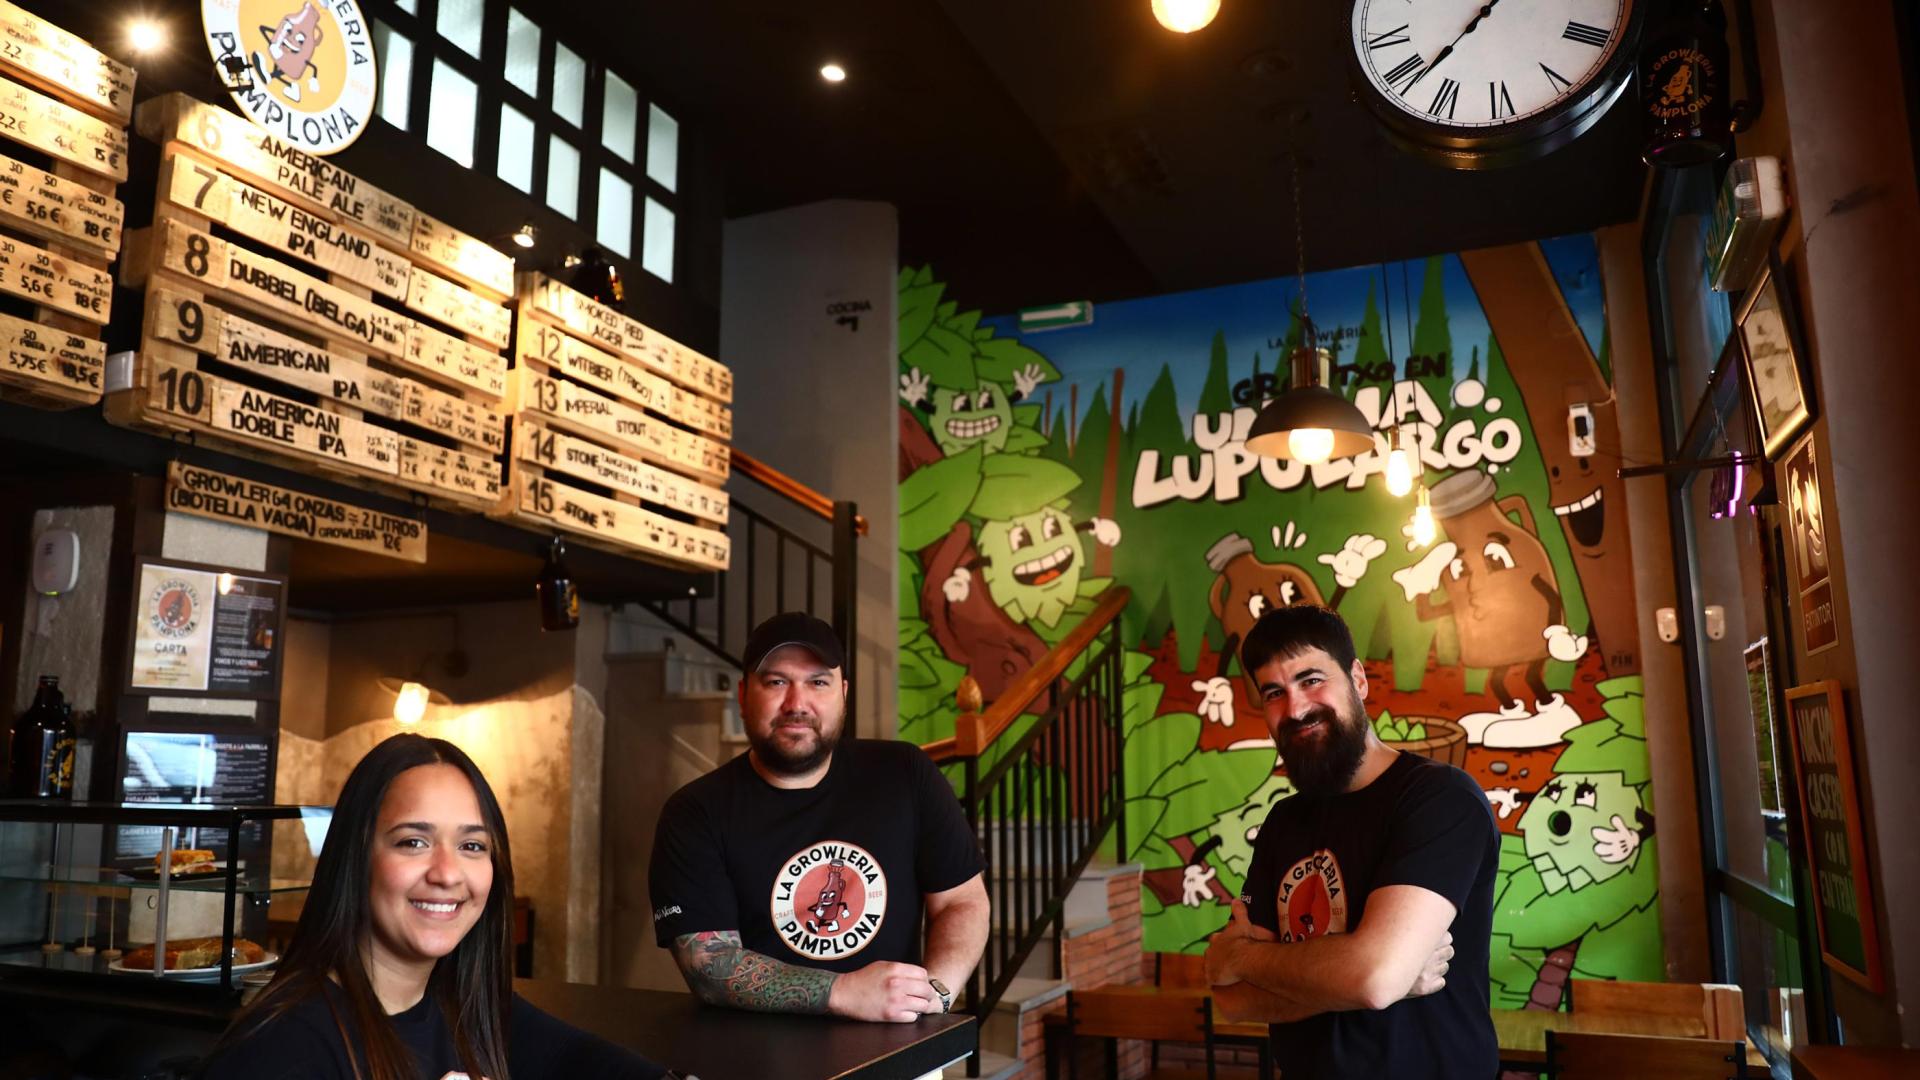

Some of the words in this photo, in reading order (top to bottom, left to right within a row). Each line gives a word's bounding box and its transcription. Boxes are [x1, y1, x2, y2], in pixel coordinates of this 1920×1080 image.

[333, 0, 368, 66] ERIA
[211, 31, 359, 145] PMPLONA
[199, 111, 223, 151] 6
[259, 135, 356, 195] AMERICAN
[44, 175, 57, 187] 50
[278, 166, 324, 202] PALE
[331, 193, 364, 221] ALE
[192, 166, 218, 209] 7
[240, 186, 287, 221] NEW
[290, 210, 370, 260] ENGLAND
[288, 231, 317, 260] IPA
[184, 233, 209, 278] 8
[230, 258, 304, 307] DUBBEL
[177, 300, 204, 343] 9
[229, 340, 330, 374] AMERICAN
[537, 327, 562, 364] 12
[1405, 351, 1447, 380] EN
[158, 367, 205, 415] 10
[240, 391, 340, 435] AMERICAN
[333, 379, 362, 401] IPA
[533, 378, 558, 412] 13
[231, 410, 296, 444] DOBLE
[318, 434, 347, 458] IPA
[531, 430, 556, 465] 14
[566, 448, 599, 468] STONE
[616, 420, 647, 435] STOUT
[170, 486, 256, 522] (BOTELLA
[184, 470, 270, 506] GROWLER
[294, 496, 345, 523] ONZAS
[362, 512, 370, 530] 2
[372, 515, 420, 538] LITROS
[528, 479, 554, 514] 15
[154, 642, 188, 657] CARTA
[777, 881, 794, 901] LA
[788, 845, 879, 885] GROWLERIA
[1280, 882, 1293, 904] LA
[1292, 855, 1341, 899] GROLERIA
[780, 912, 881, 955] PAMPLONA
